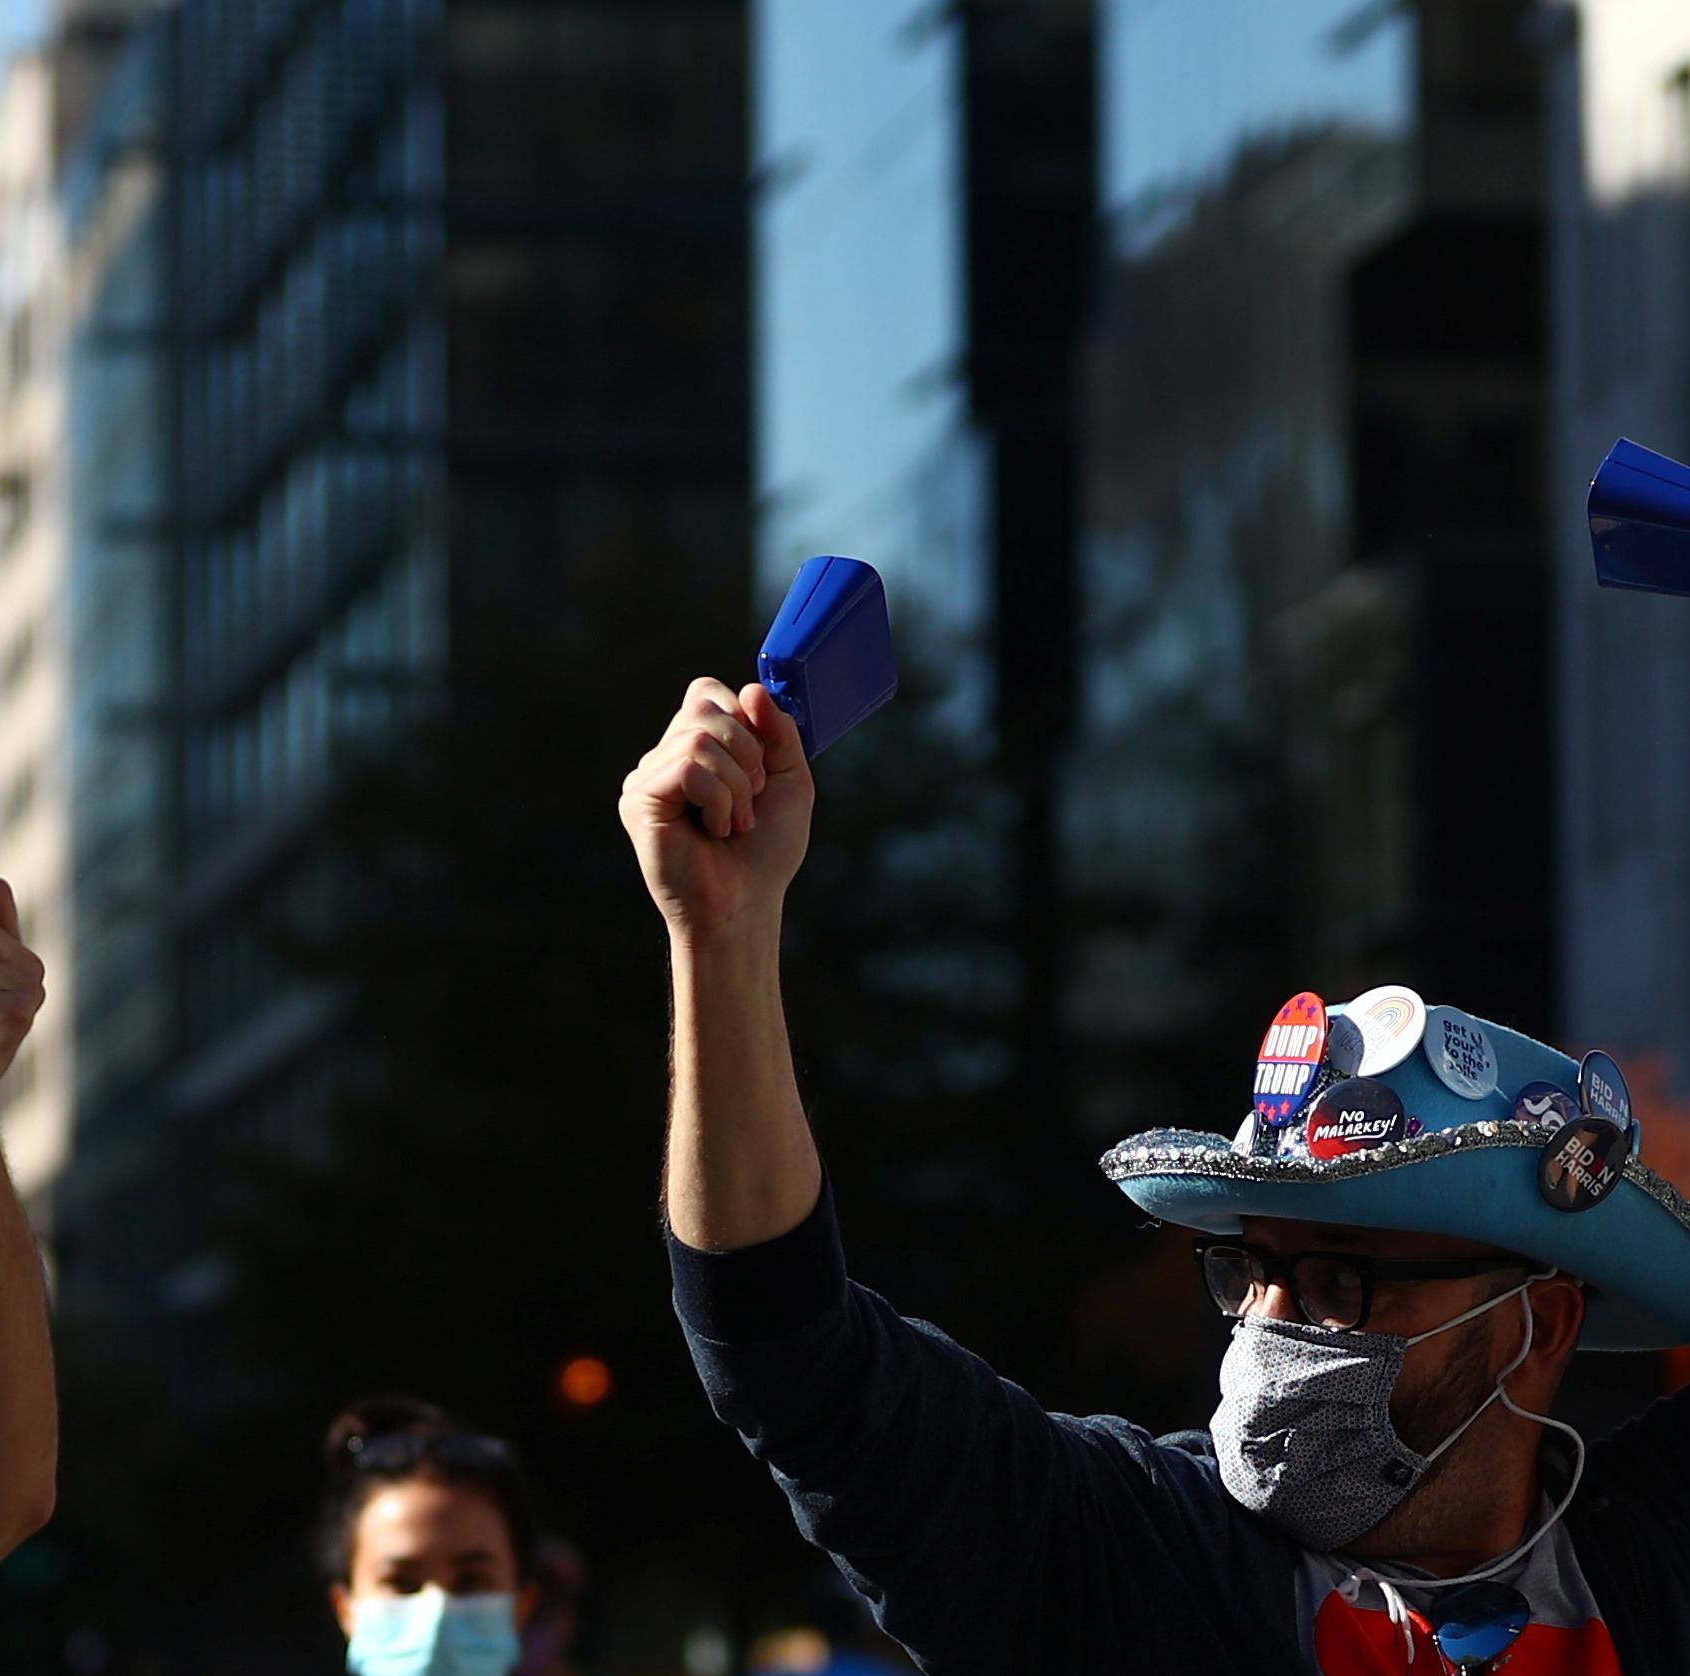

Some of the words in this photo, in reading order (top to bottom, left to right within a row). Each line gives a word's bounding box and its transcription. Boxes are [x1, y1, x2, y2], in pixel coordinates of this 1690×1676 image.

[1263, 1024, 1319, 1058] DUMP
[1443, 1019, 1467, 1038] get
[1444, 1032, 1475, 1054] your
[1444, 1042, 1459, 1059] to
[1462, 1051, 1484, 1072] the
[1253, 1063, 1310, 1096] TRUMP
[1339, 1110, 1365, 1124] NO
[1589, 1086, 1628, 1132] HARRIS
[1312, 1113, 1398, 1143] MALARKEY!
[1554, 1150, 1604, 1197] HARRIS
